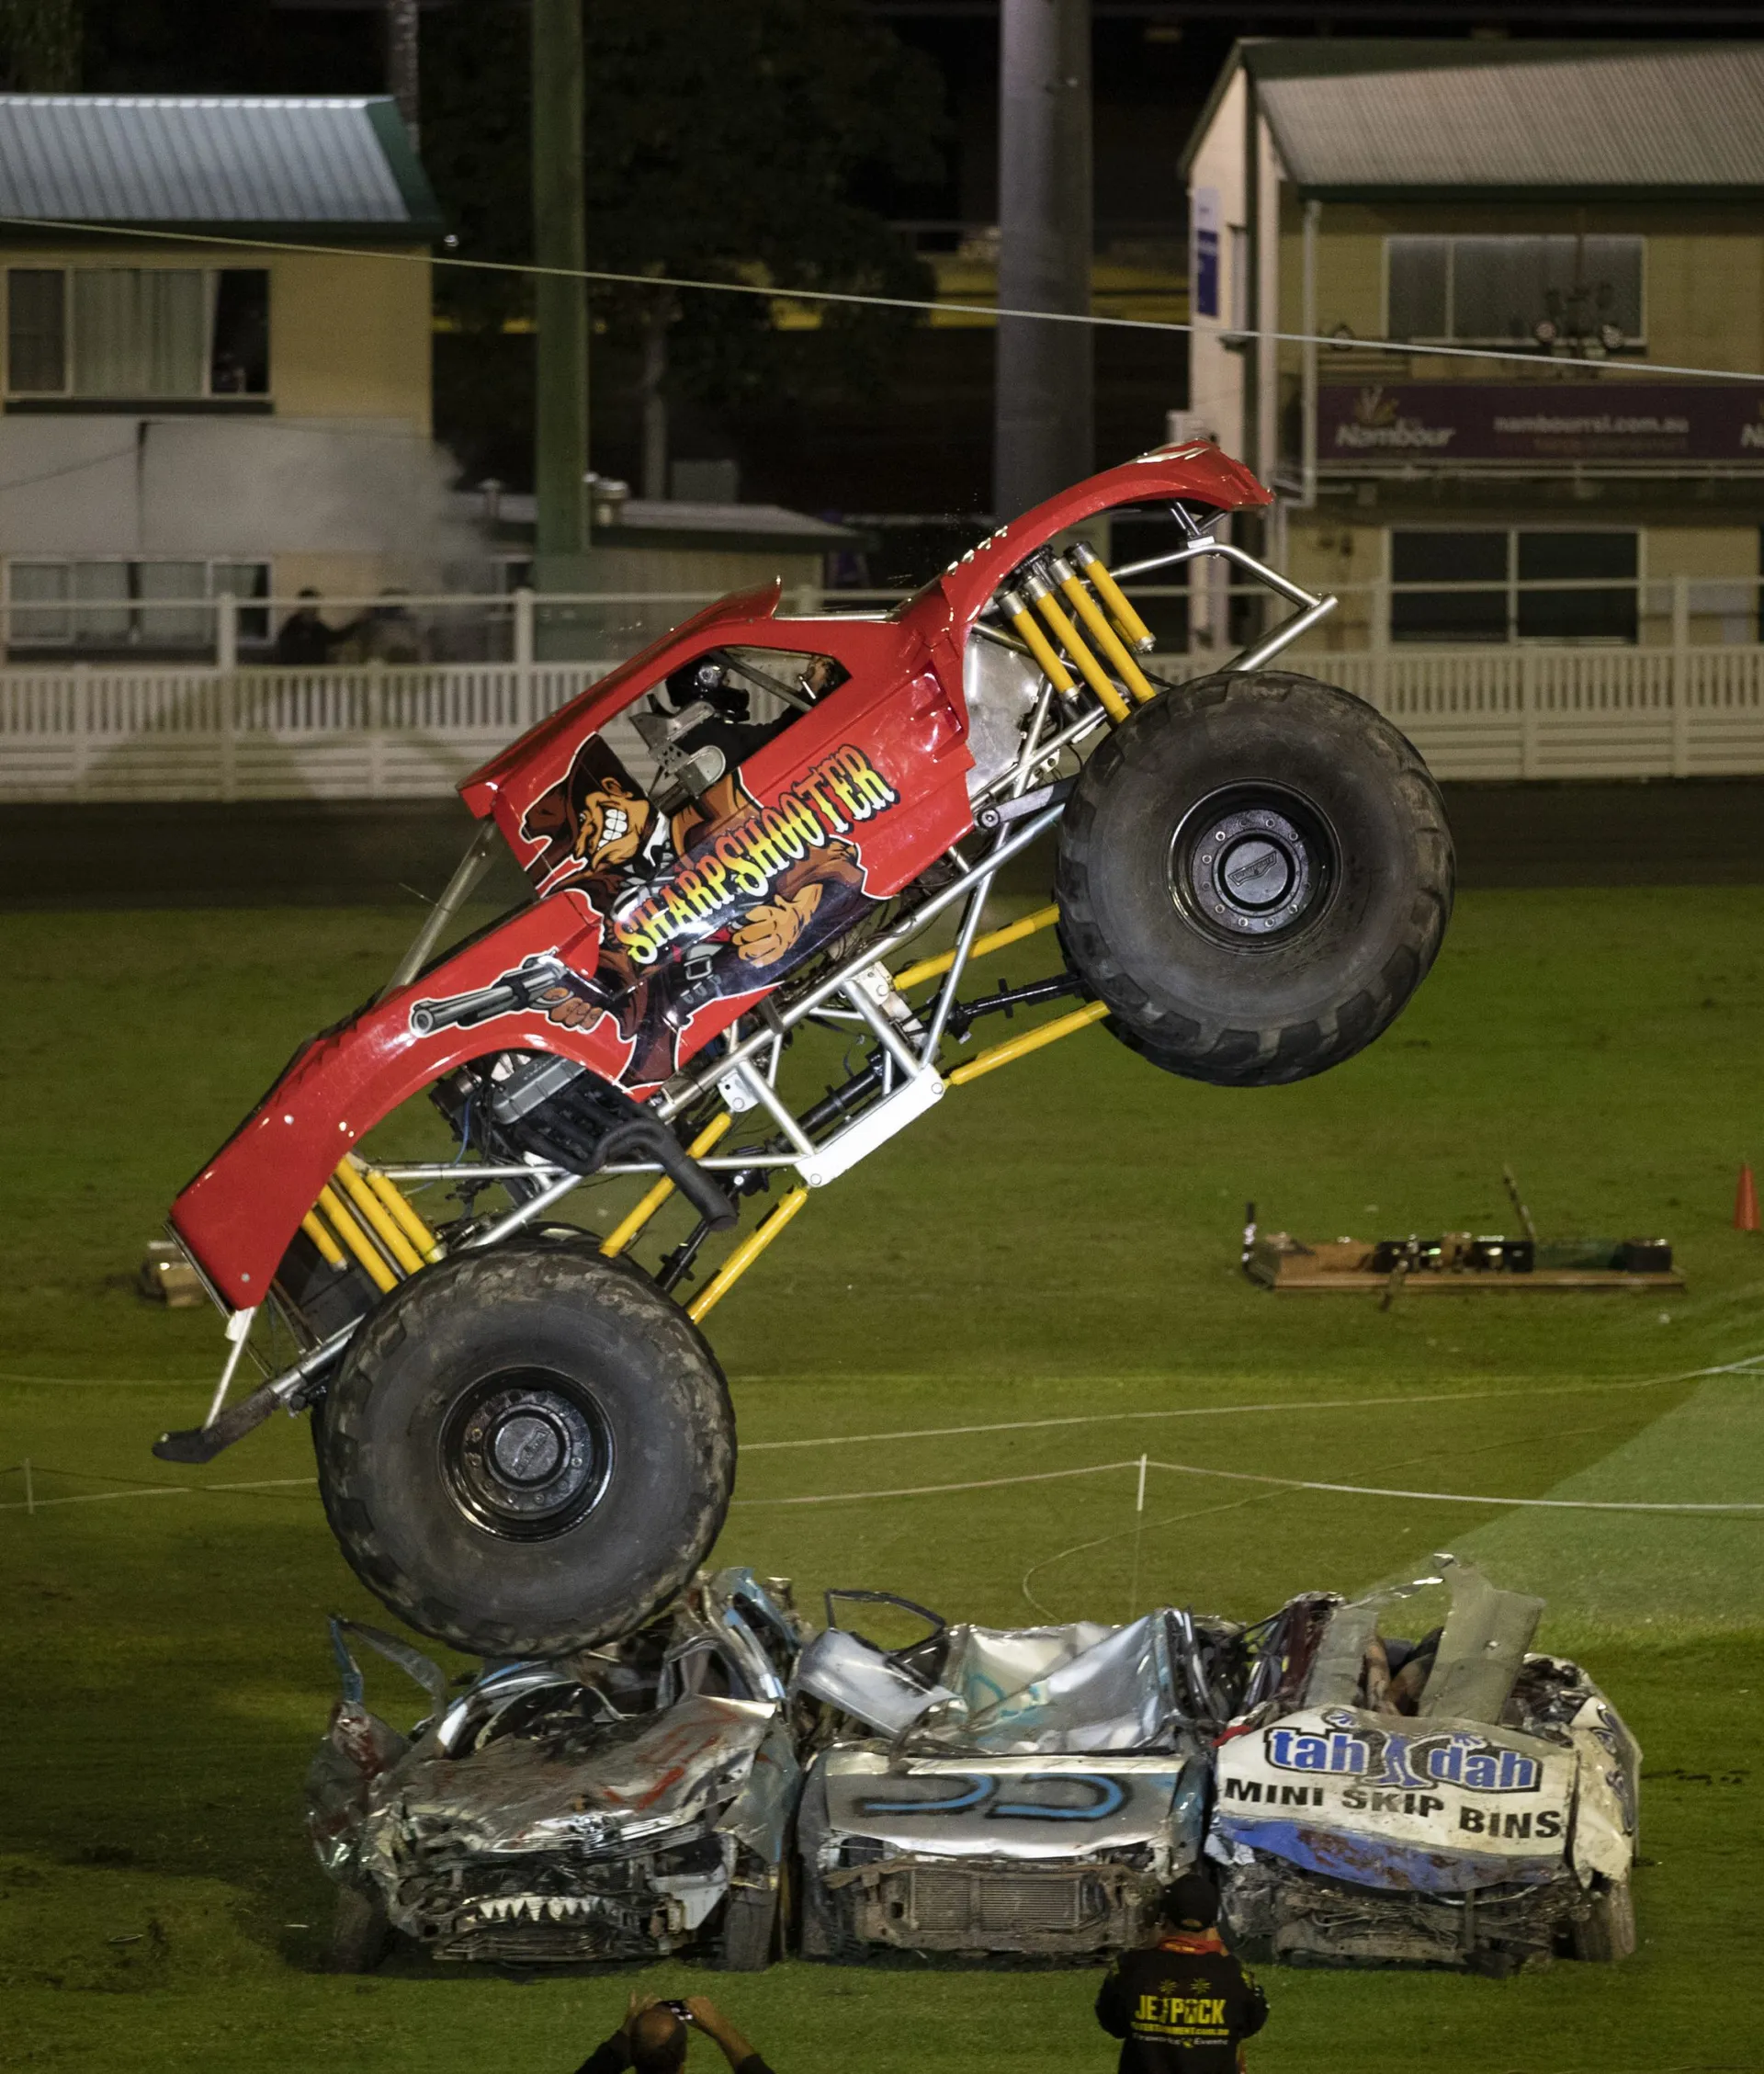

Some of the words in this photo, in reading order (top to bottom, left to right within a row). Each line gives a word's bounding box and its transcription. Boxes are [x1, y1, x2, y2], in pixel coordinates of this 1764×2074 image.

[1336, 417, 1455, 448] Nambour
[614, 743, 900, 965] SHARPSHOOTER
[1269, 1728, 1368, 1774] tah
[1428, 1746, 1535, 1791] dah
[1225, 1778, 1324, 1807] MINI
[1341, 1787, 1444, 1818] SKIP
[1460, 1806, 1561, 1839] BINS
